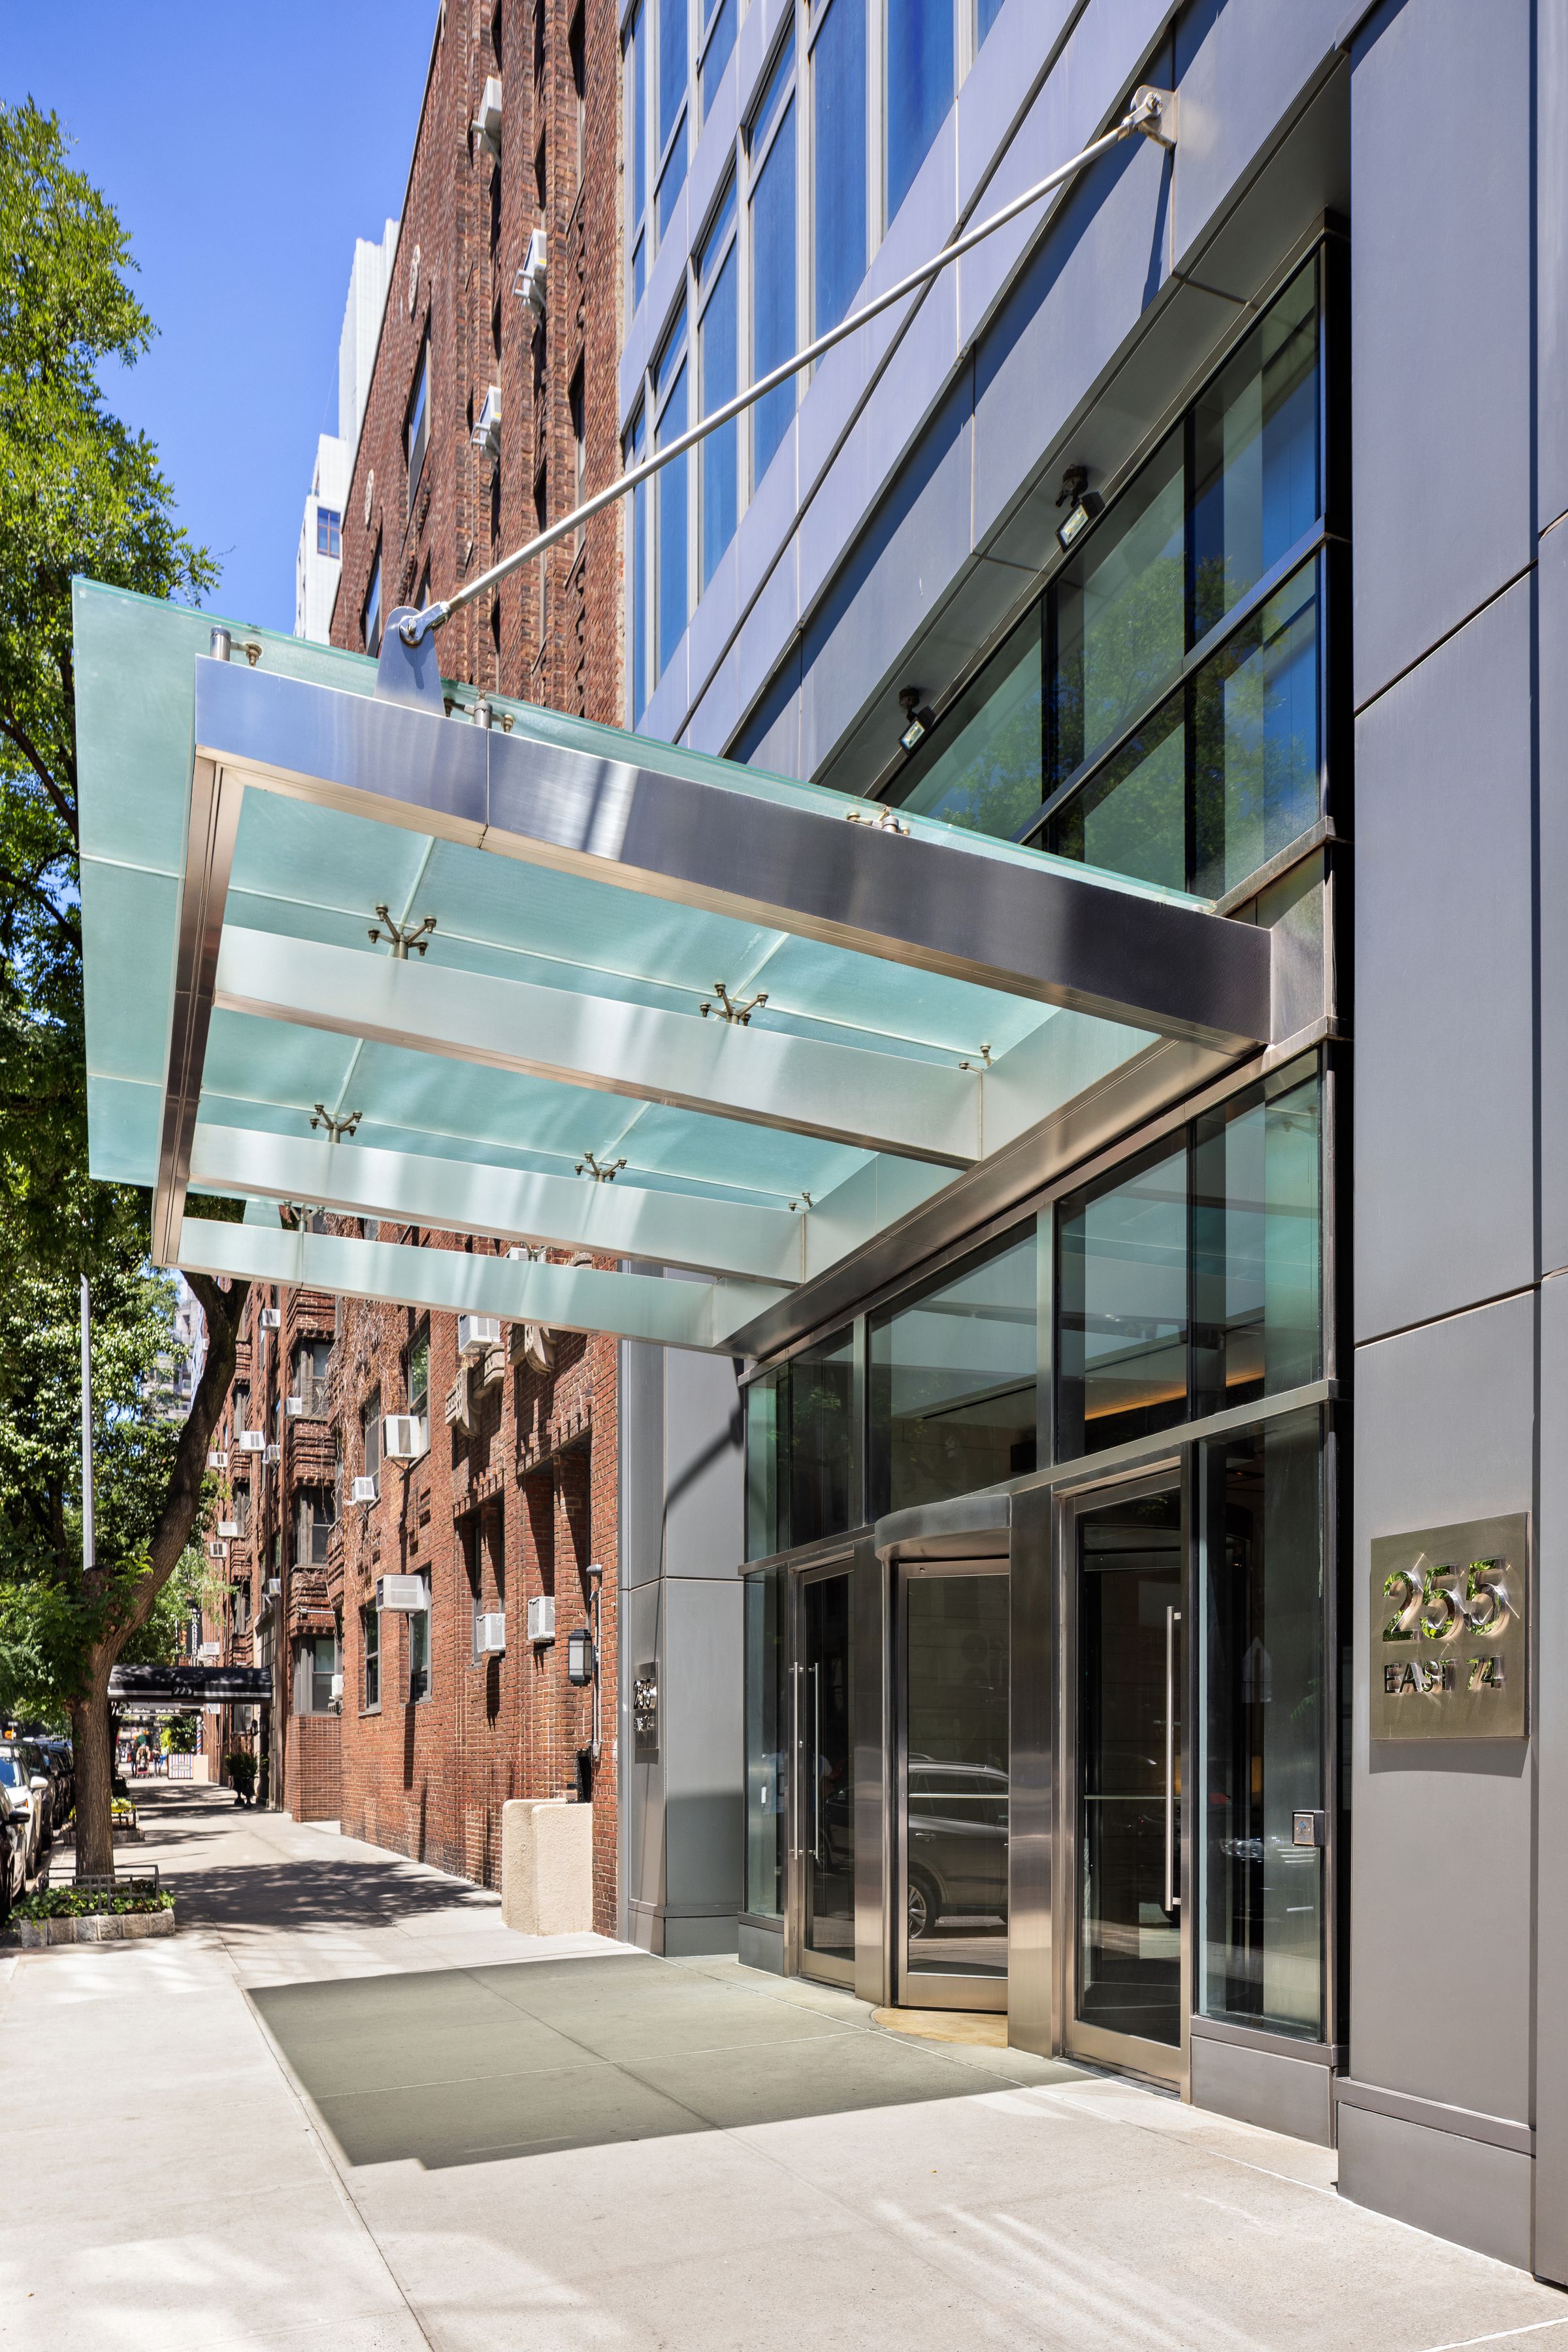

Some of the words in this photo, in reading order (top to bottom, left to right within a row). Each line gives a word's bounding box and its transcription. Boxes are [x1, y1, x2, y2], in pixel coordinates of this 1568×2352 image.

[1382, 1558, 1507, 1642] 255
[1384, 1658, 1456, 1693] EAST
[1466, 1656, 1504, 1691] 74
